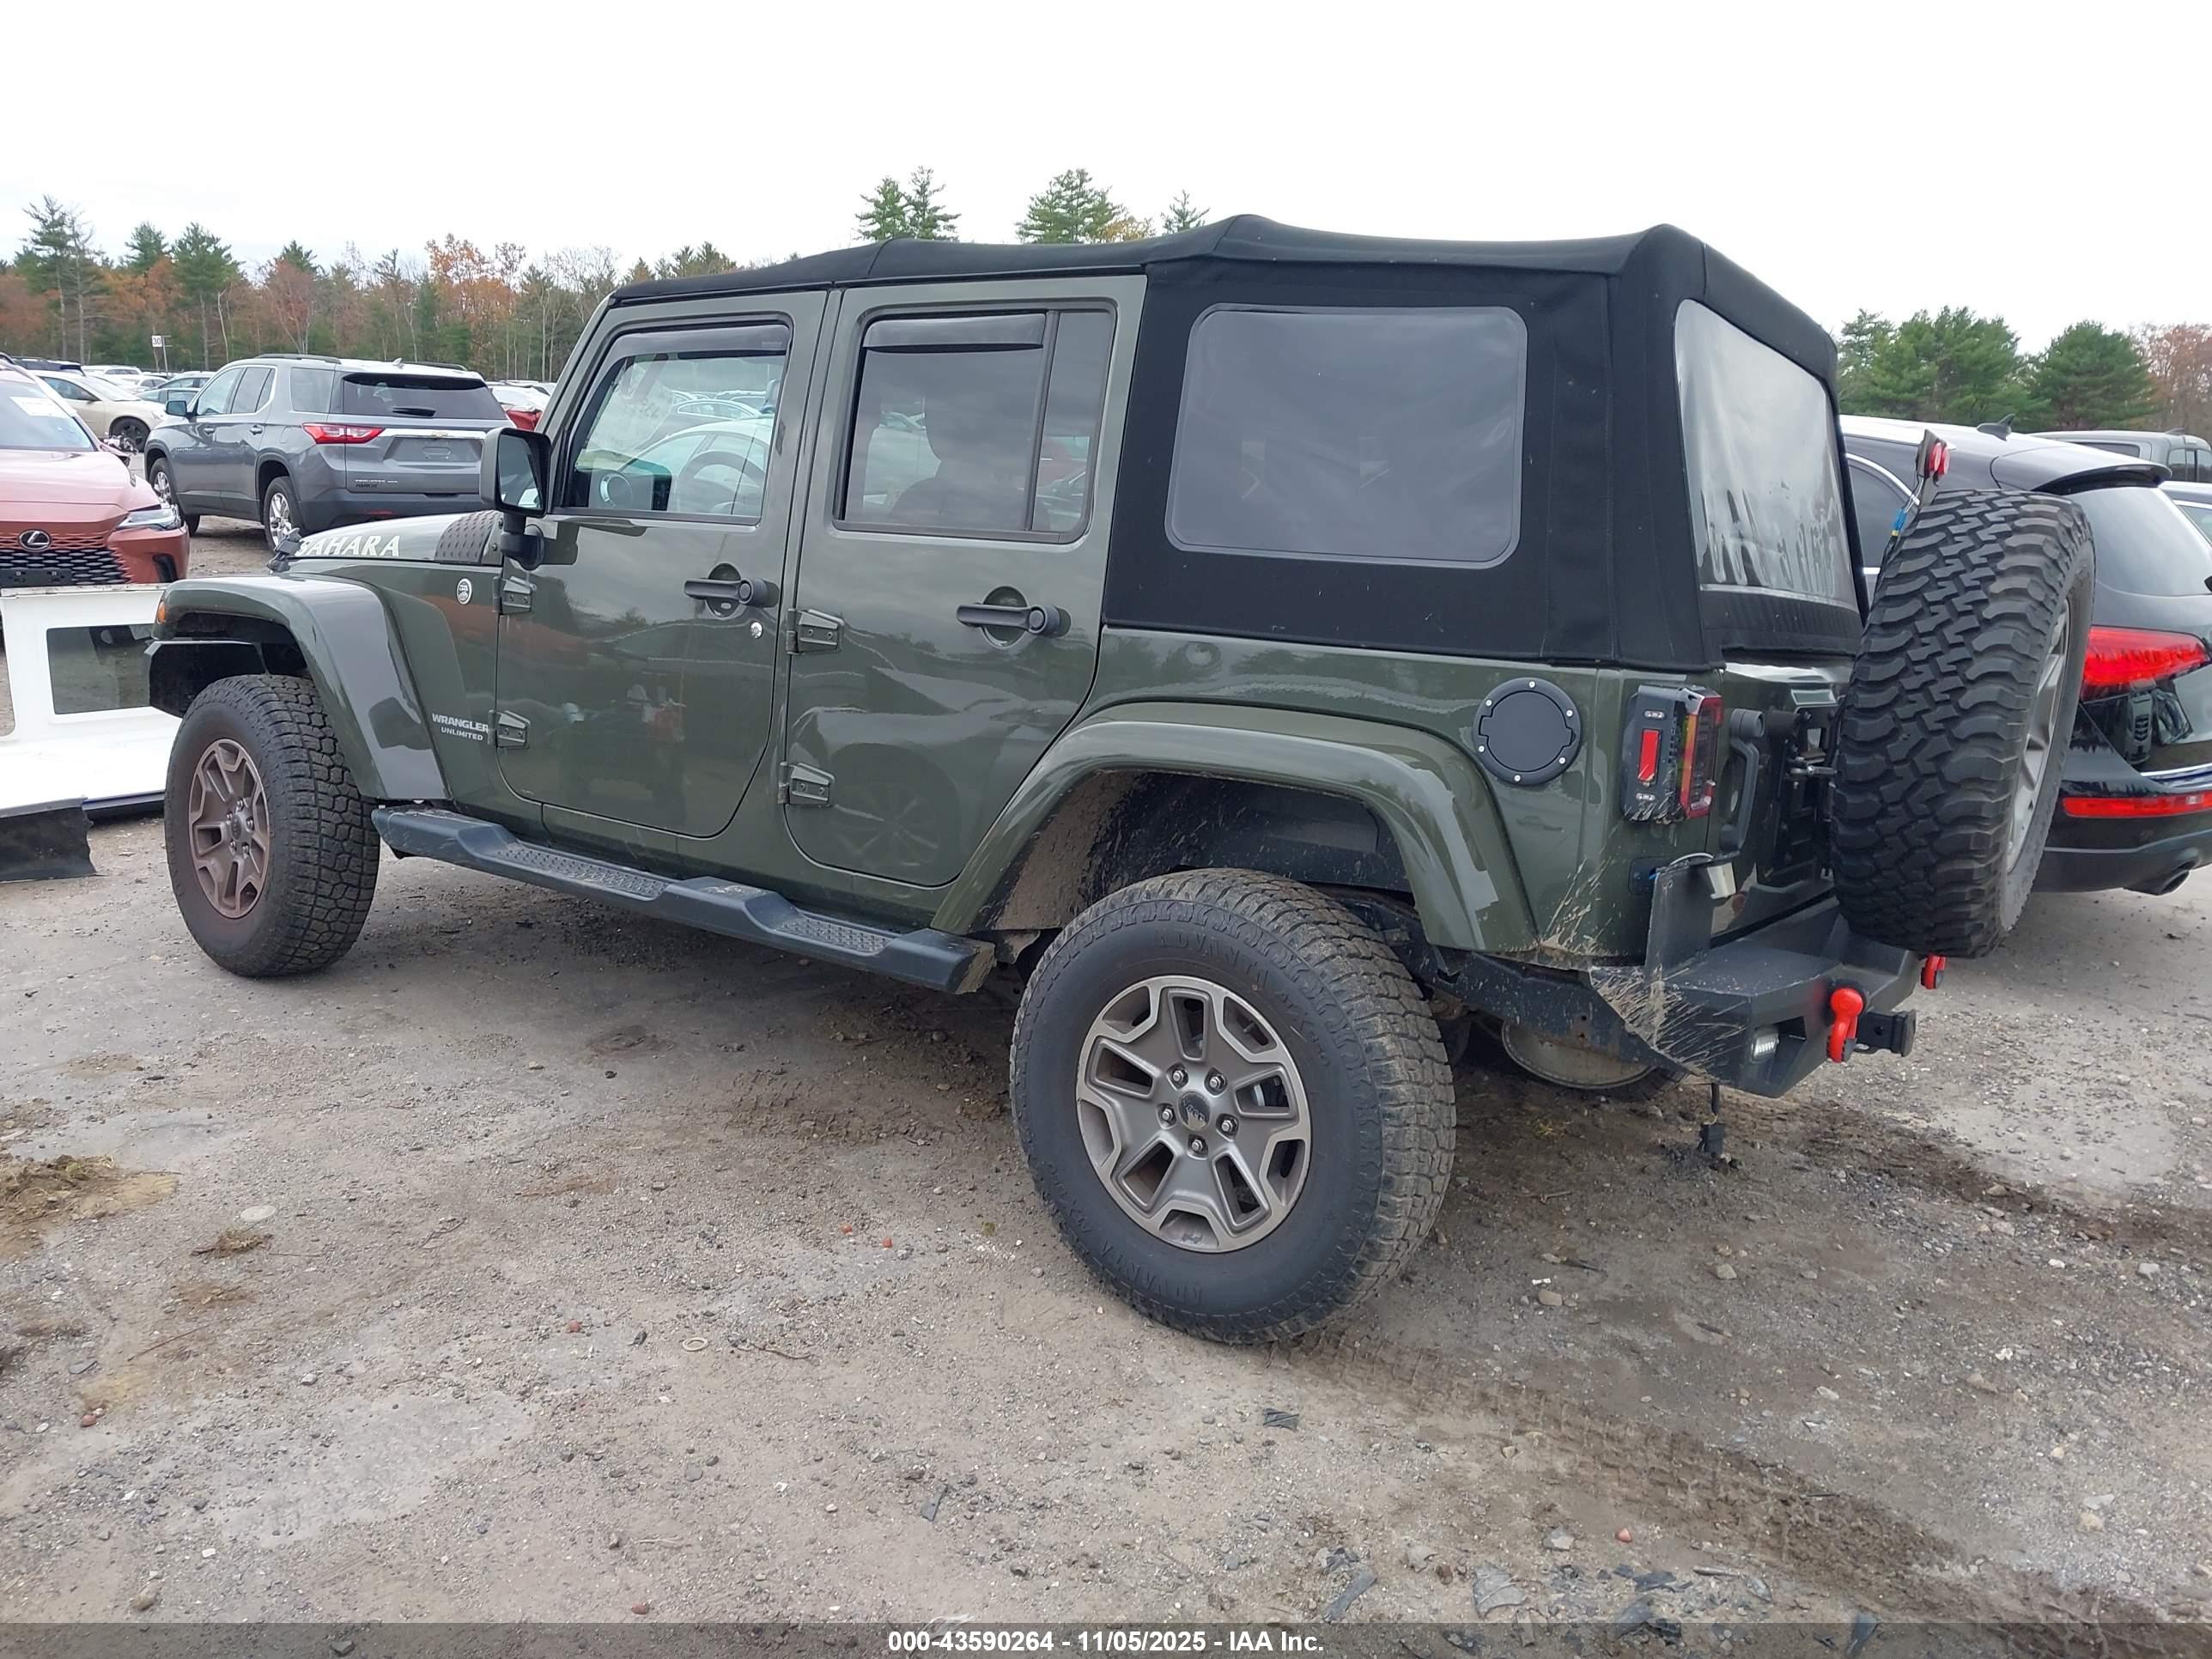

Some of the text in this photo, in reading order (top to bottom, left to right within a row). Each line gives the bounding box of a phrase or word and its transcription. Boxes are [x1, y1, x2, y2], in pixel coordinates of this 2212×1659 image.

[295, 535, 400, 557] SAHARA
[431, 713, 488, 733] WRANGLER
[441, 726, 483, 741] UNLIMITED
